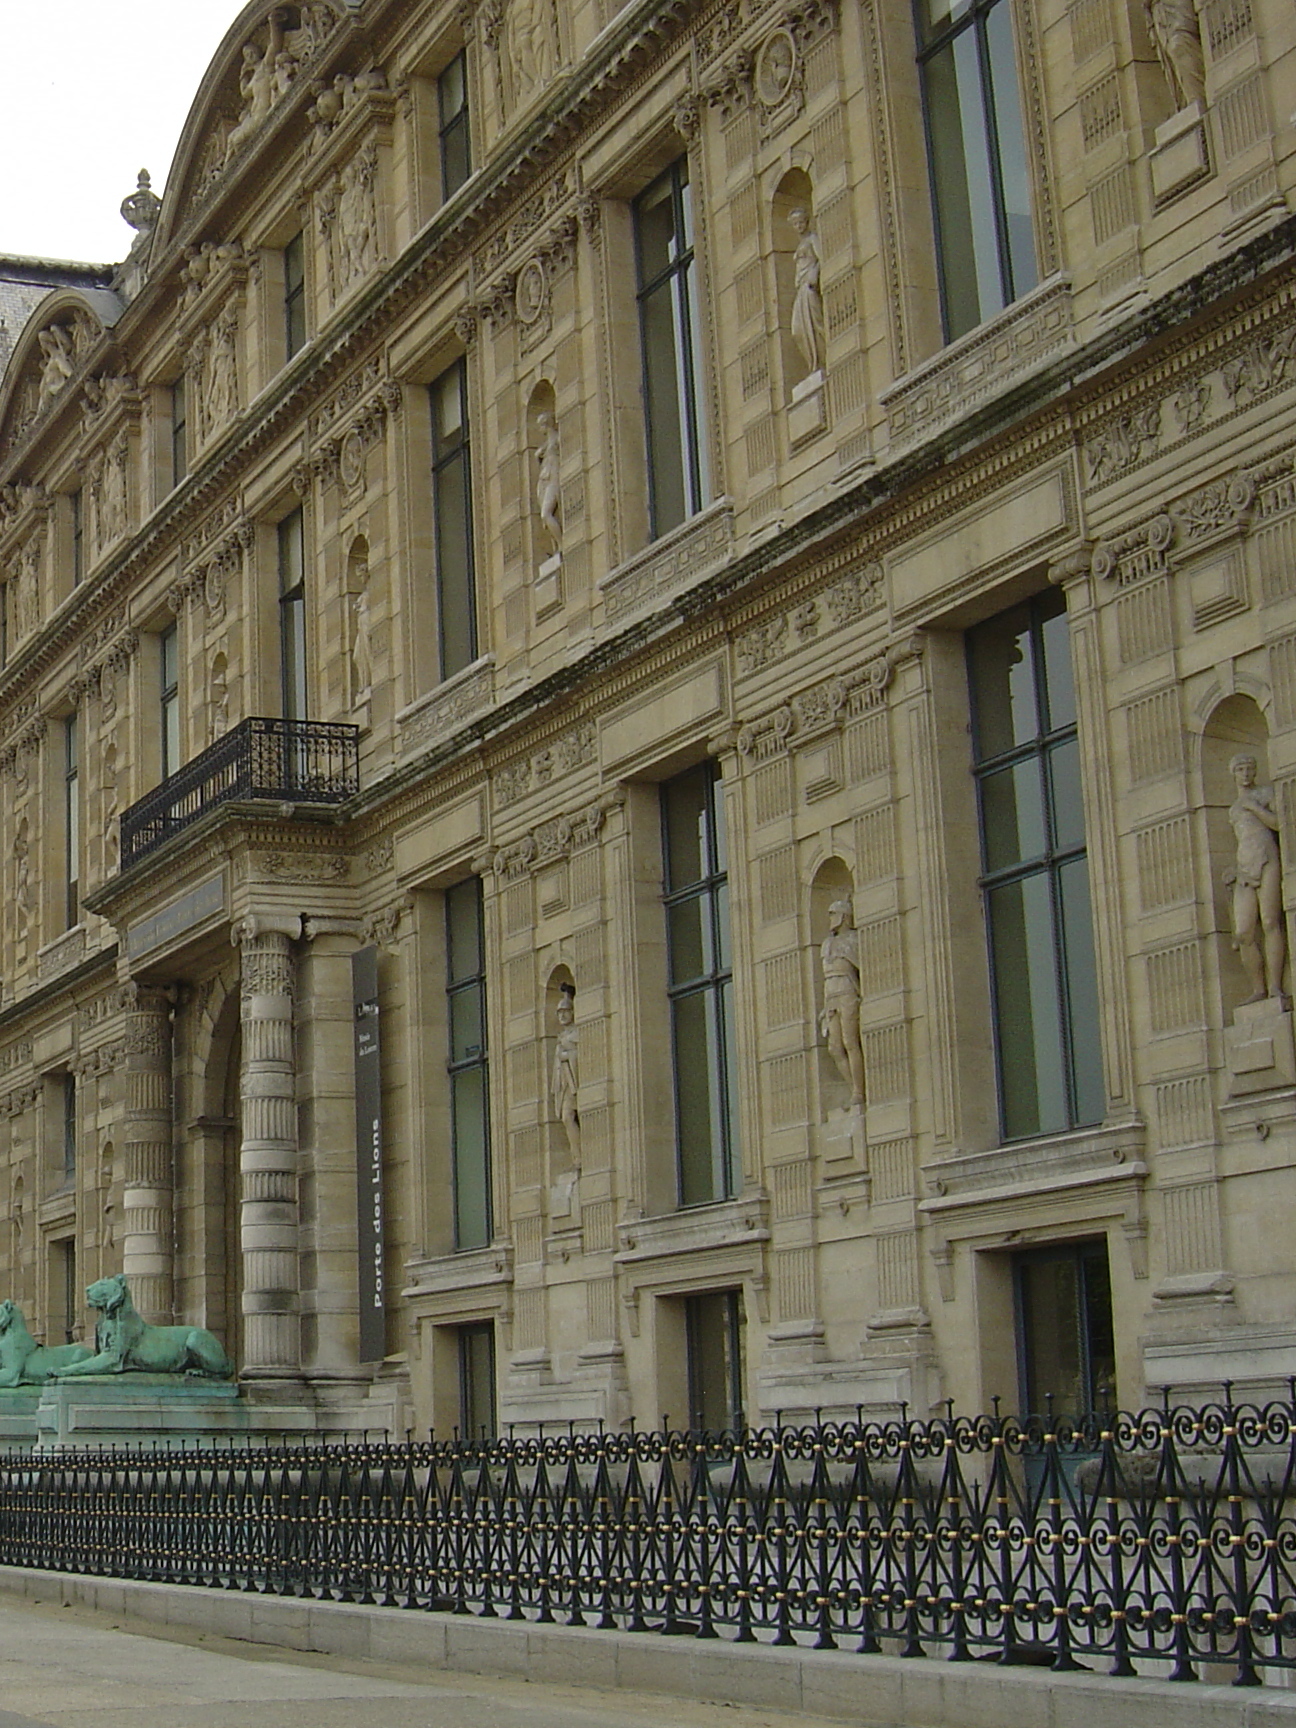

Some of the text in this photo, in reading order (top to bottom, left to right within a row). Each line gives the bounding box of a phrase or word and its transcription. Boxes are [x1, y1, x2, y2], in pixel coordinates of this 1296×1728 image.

[372, 1119, 382, 1308] Porte des Lions
